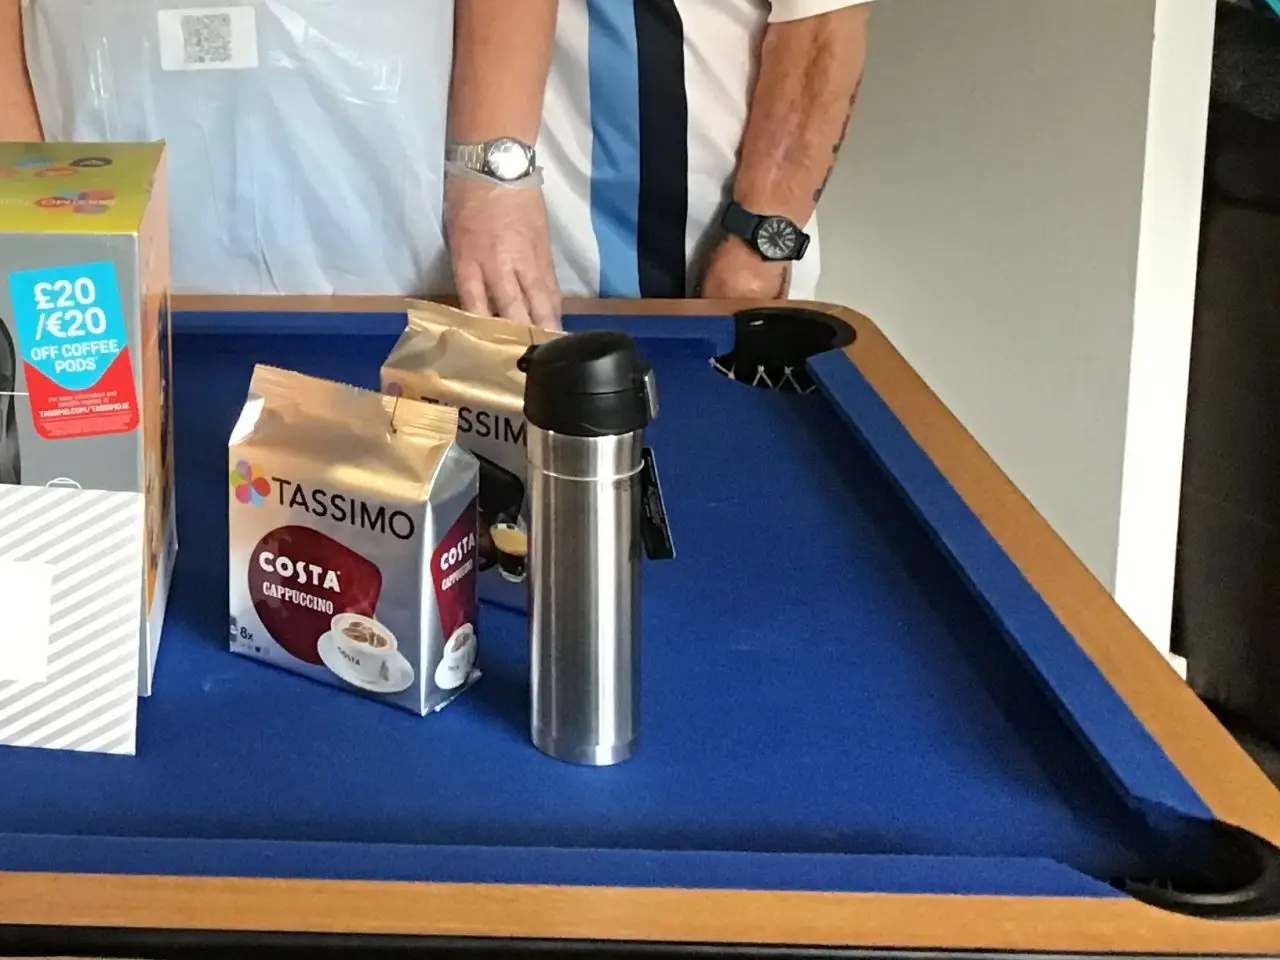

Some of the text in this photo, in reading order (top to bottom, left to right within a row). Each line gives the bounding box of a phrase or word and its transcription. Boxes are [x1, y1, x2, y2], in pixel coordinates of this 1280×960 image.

[33, 276, 96, 310] £20
[35, 306, 107, 341] /€20
[30, 338, 121, 361] OFF COFFEE
[421, 395, 528, 447] SSIM
[271, 476, 416, 540] TASSIMO
[440, 531, 476, 571] COSTA
[258, 550, 342, 593] COSTA
[262, 581, 334, 616] CAPPUCCINO
[240, 626, 254, 641] 8x
